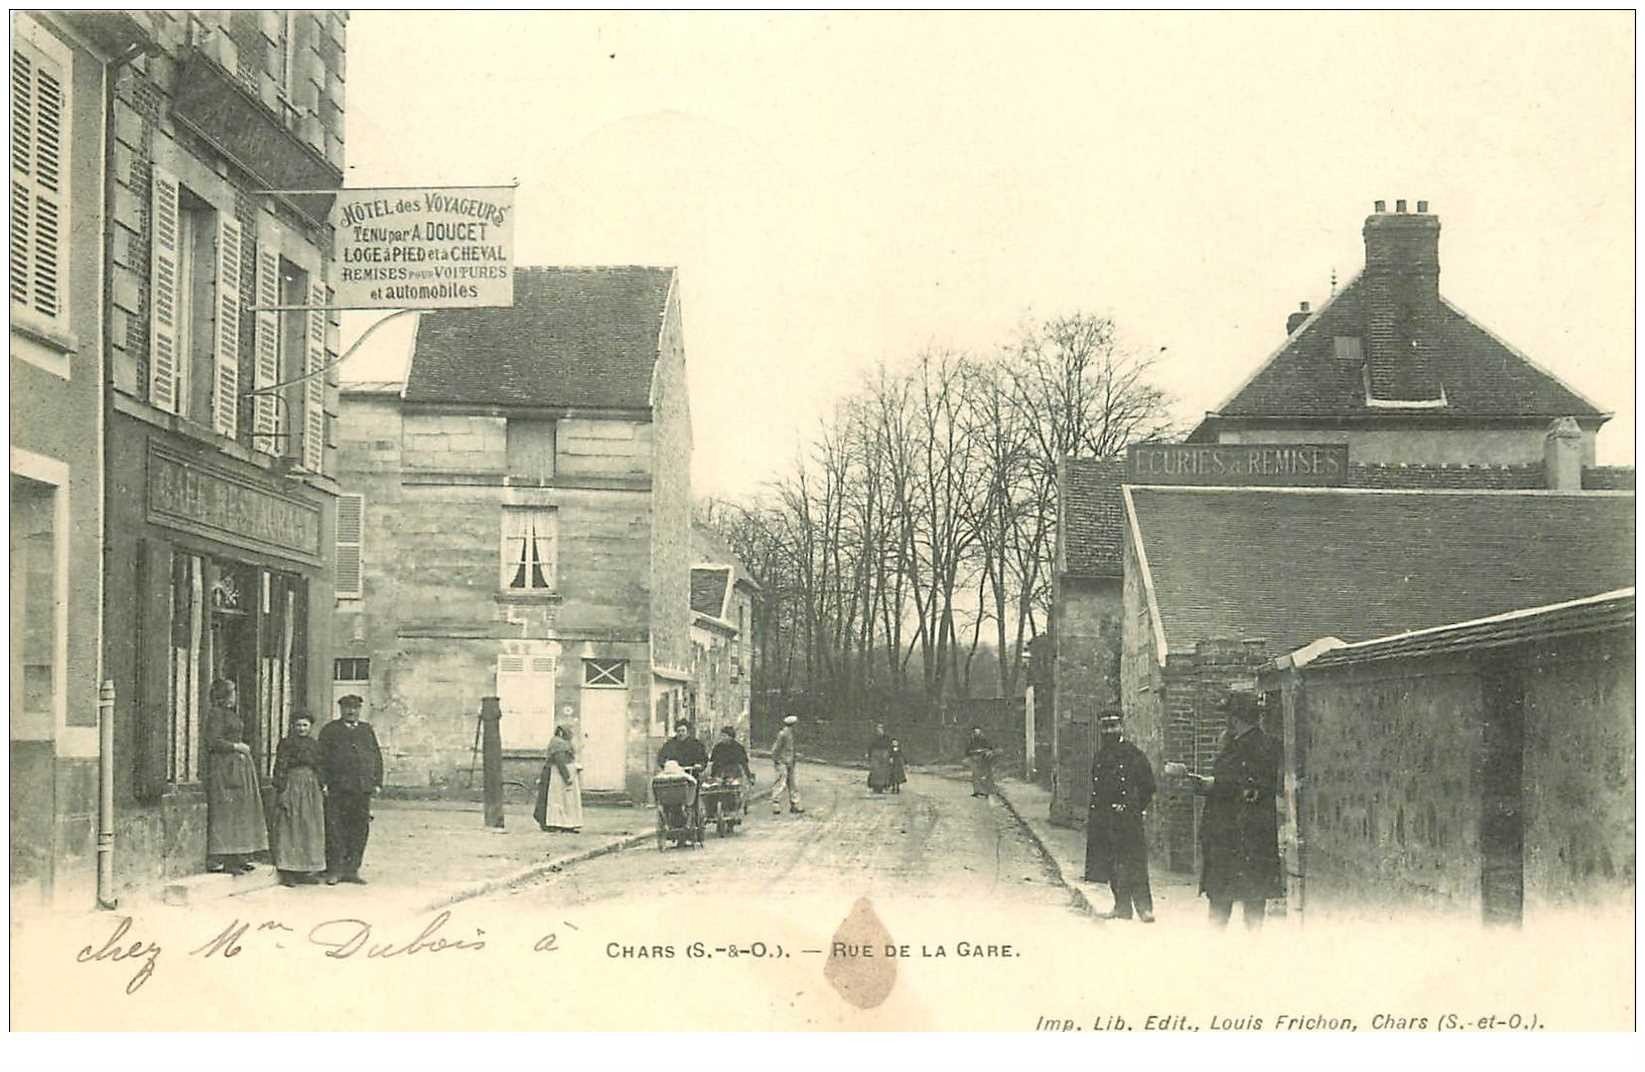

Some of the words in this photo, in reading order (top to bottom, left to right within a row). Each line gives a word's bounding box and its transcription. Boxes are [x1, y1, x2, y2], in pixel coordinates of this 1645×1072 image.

[395, 199, 421, 213] des
[424, 193, 511, 228] VOYAGEURS
[353, 225, 387, 243] TENU
[426, 221, 488, 242] DOUCET
[344, 247, 381, 263] LOGE
[392, 247, 426, 262] PIED
[450, 245, 507, 262] CHEVAL
[342, 266, 408, 282] REMISES
[433, 266, 508, 281] VOITURES
[370, 288, 383, 300] et
[385, 282, 479, 300] automobiles
[1249, 448, 1340, 475] REMISES
[76, 916, 163, 994] chez
[308, 910, 487, 960] Dubois
